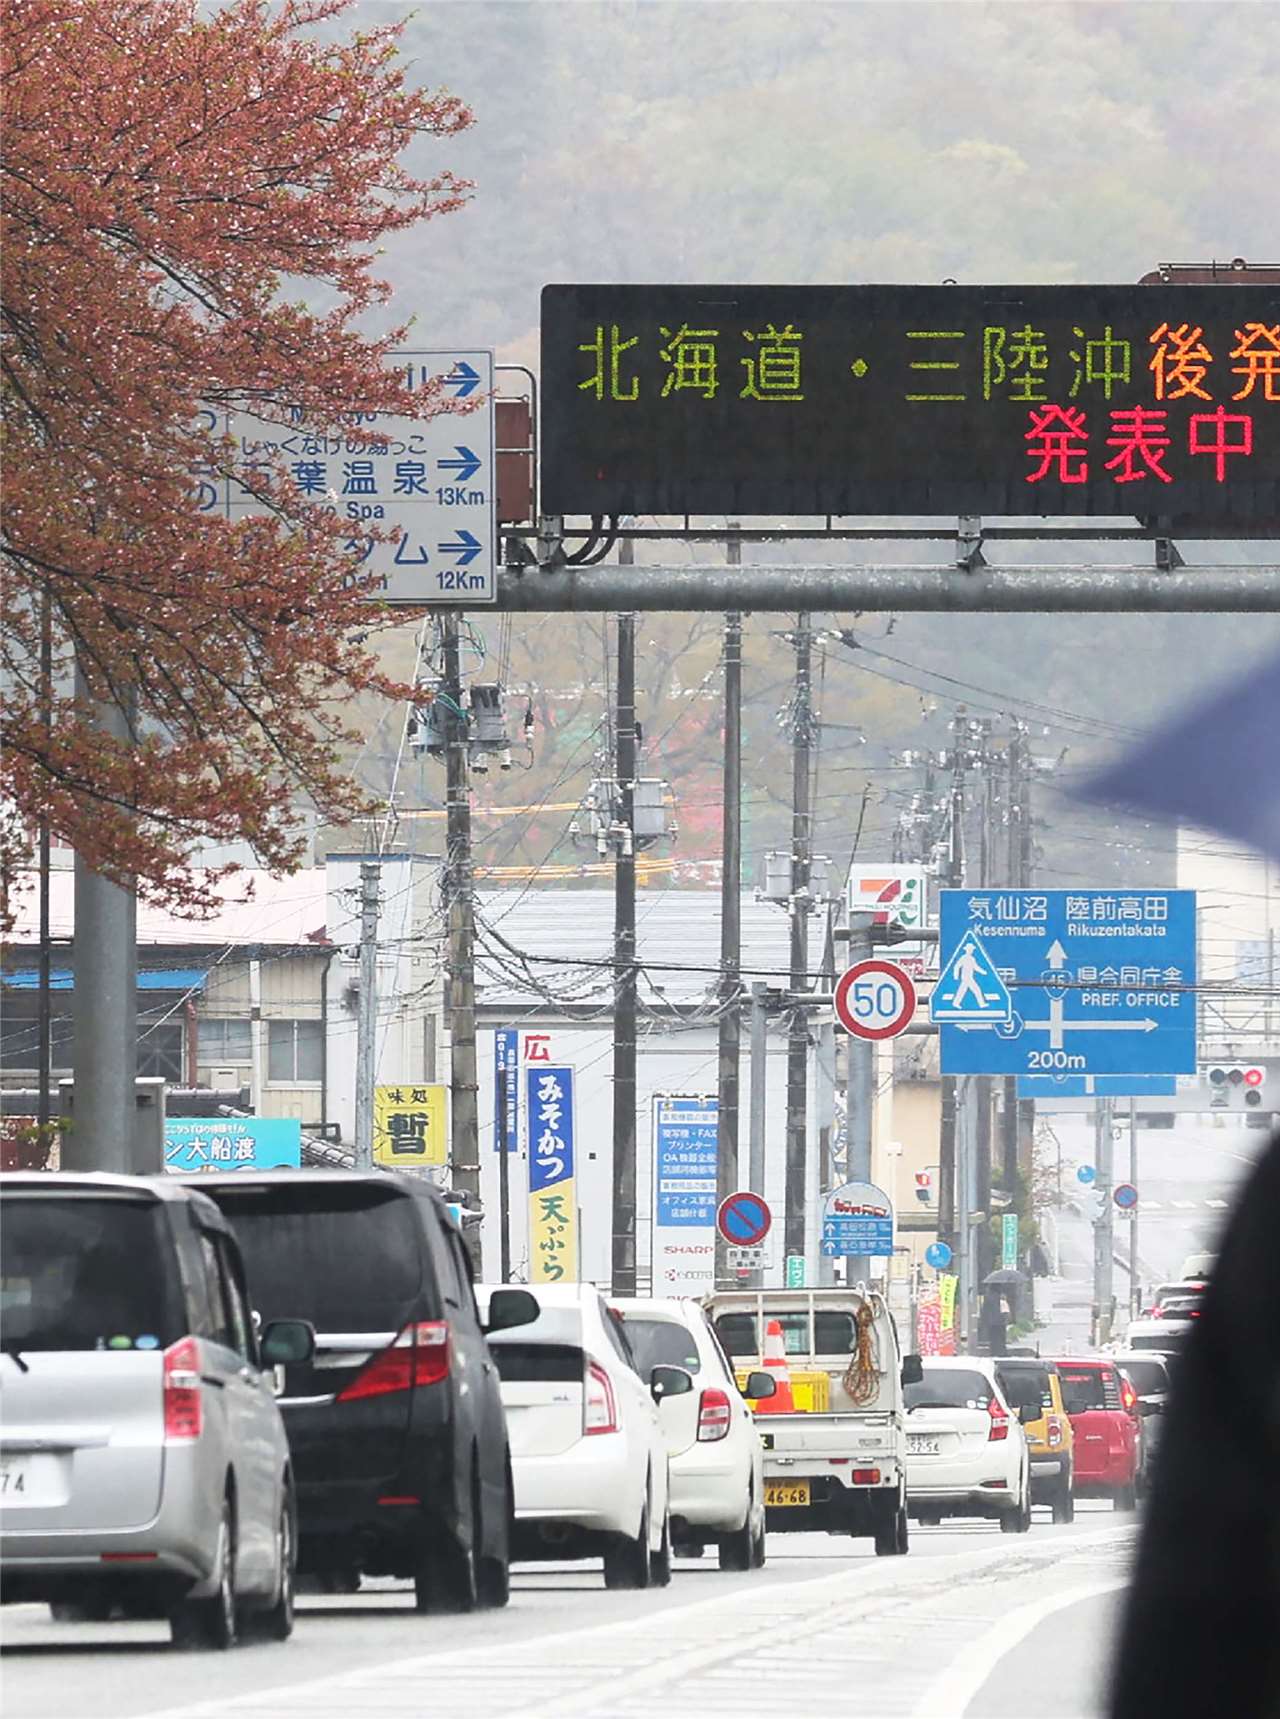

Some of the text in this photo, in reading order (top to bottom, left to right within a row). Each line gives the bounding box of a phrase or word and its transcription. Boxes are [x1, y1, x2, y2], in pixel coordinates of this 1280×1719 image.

[1024, 403, 1254, 484] 発表中
[436, 488, 484, 506] 13Km
[346, 502, 385, 520] Spa
[436, 573, 485, 590] 12Km
[967, 896, 1168, 921] 気仙沼 陸前高田
[973, 923, 1167, 937] Kesennuma Rikuzentakata
[854, 983, 898, 1018] 50
[1081, 993, 1180, 1008] PREF. OFFICE
[1027, 1051, 1086, 1070] 200m
[388, 1088, 429, 1104] 味処
[536, 1073, 565, 1180] みそかつ
[538, 1195, 570, 1282] 天ぷら
[664, 1246, 713, 1255] SHARP
